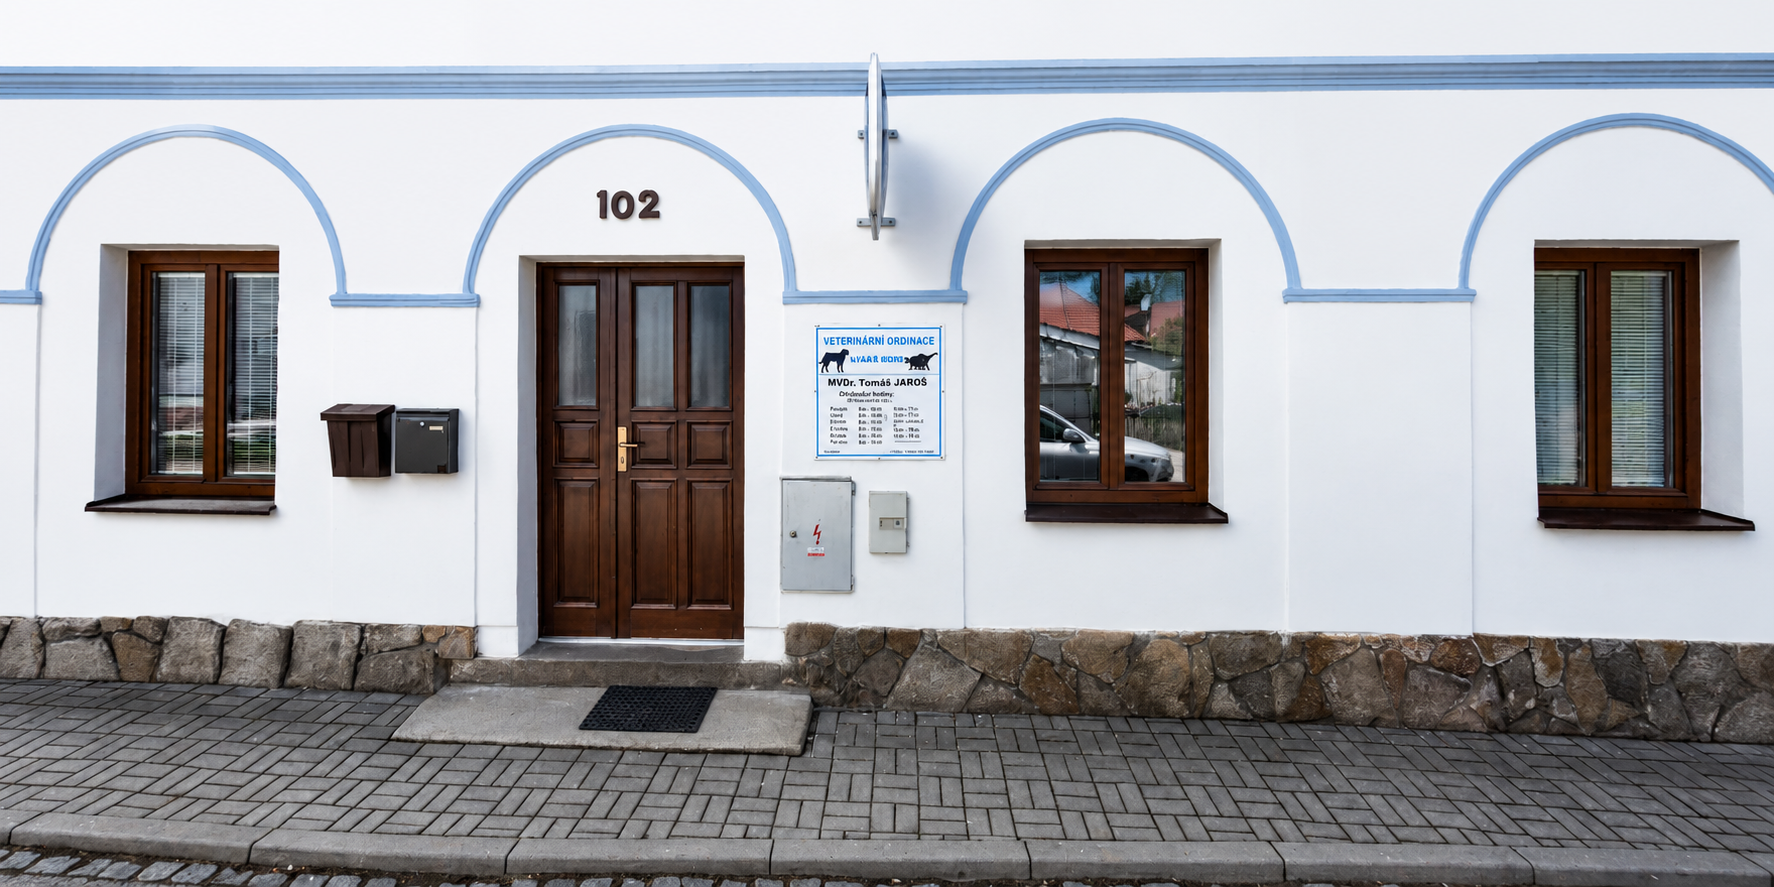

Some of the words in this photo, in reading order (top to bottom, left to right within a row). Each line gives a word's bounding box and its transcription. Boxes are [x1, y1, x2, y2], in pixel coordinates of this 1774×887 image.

[597, 190, 660, 220] 102
[823, 335, 885, 345] VETERINÁRNÍ
[887, 337, 935, 345] ORDINACE
[828, 378, 856, 387] MVDr.
[859, 378, 891, 387] Tomáš
[894, 377, 927, 387] JAROŠ
